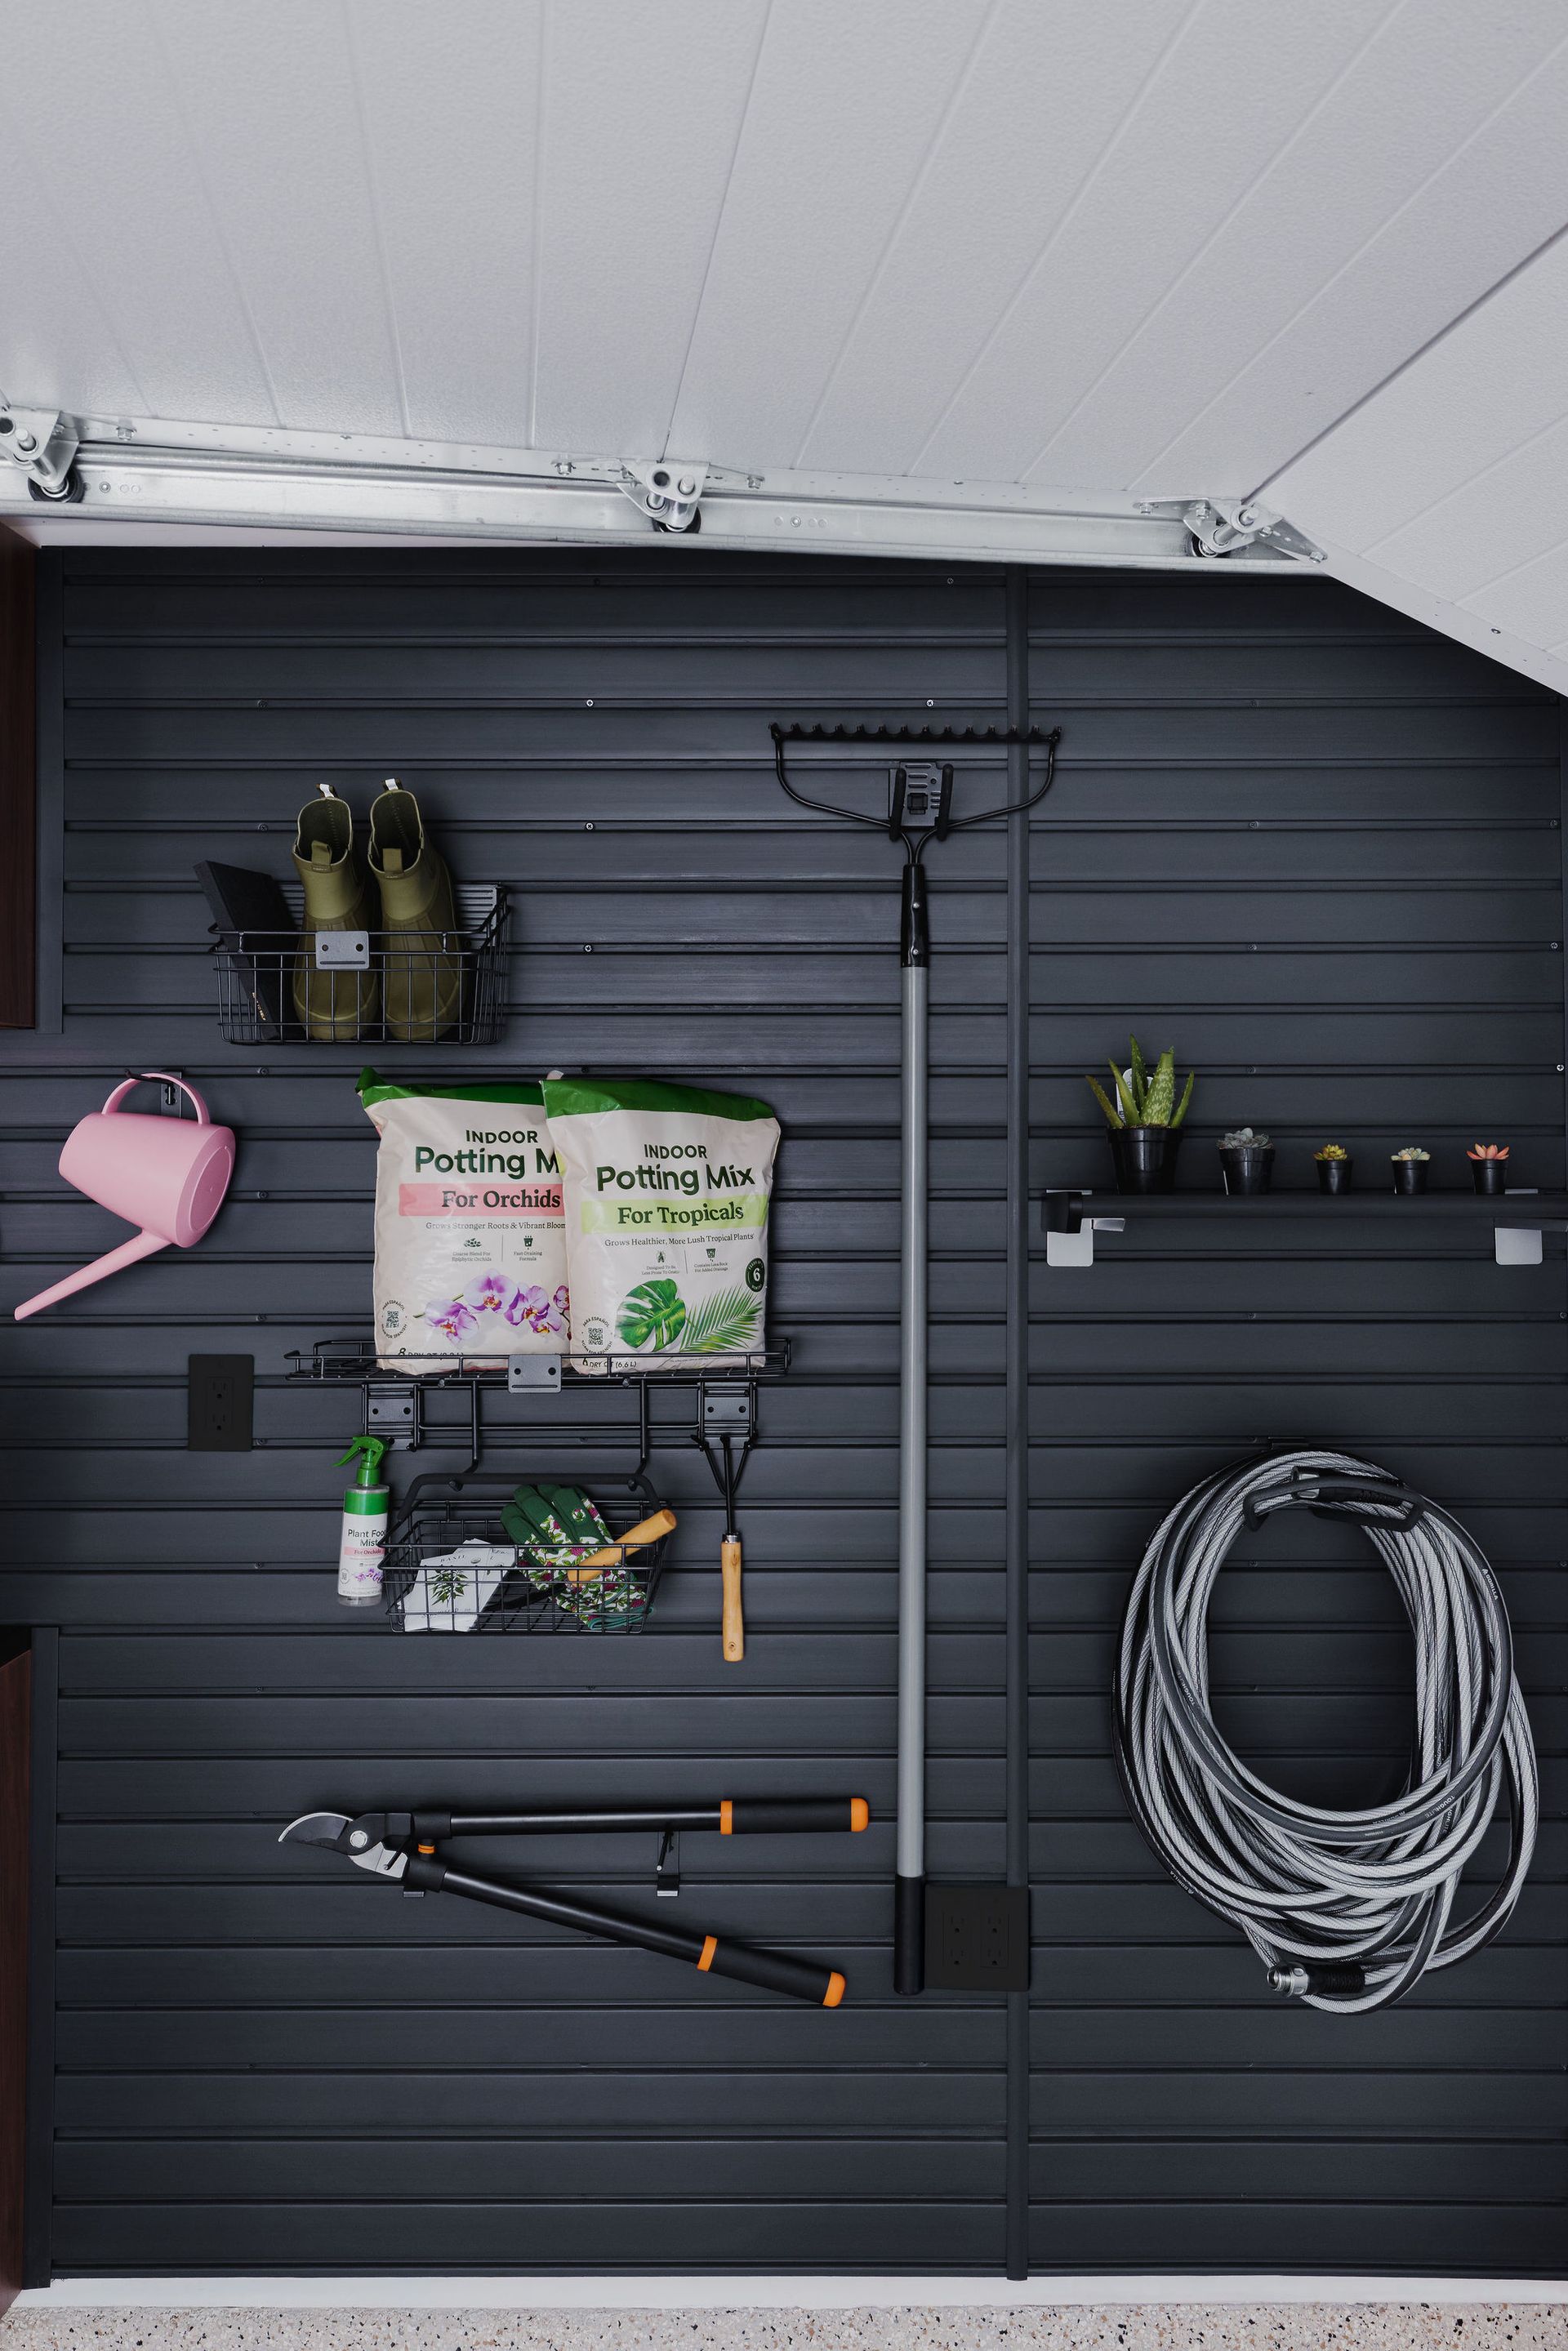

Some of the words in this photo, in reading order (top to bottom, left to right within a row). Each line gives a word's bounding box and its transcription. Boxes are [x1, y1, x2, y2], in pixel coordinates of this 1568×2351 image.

[466, 1130, 538, 1143] INDOOR
[644, 1144, 707, 1159] INDOOR
[415, 1147, 525, 1179] Potting
[596, 1164, 700, 1196] Potting
[706, 1164, 755, 1190] Mix
[442, 1190, 478, 1208] For
[483, 1188, 560, 1208] Orchids
[617, 1207, 653, 1224] For
[657, 1201, 744, 1227] Tropicals
[452, 1222, 486, 1231] Stronger
[546, 1221, 566, 1229] Bloom
[631, 1237, 668, 1245] Healthier,
[687, 1236, 705, 1244] Lush
[706, 1233, 733, 1243] Tropical
[753, 1267, 760, 1281] 6
[348, 1529, 369, 1538] Plant
[360, 1538, 378, 1547] Mist
[1424, 1795, 1455, 1819] TOUGHLITE
